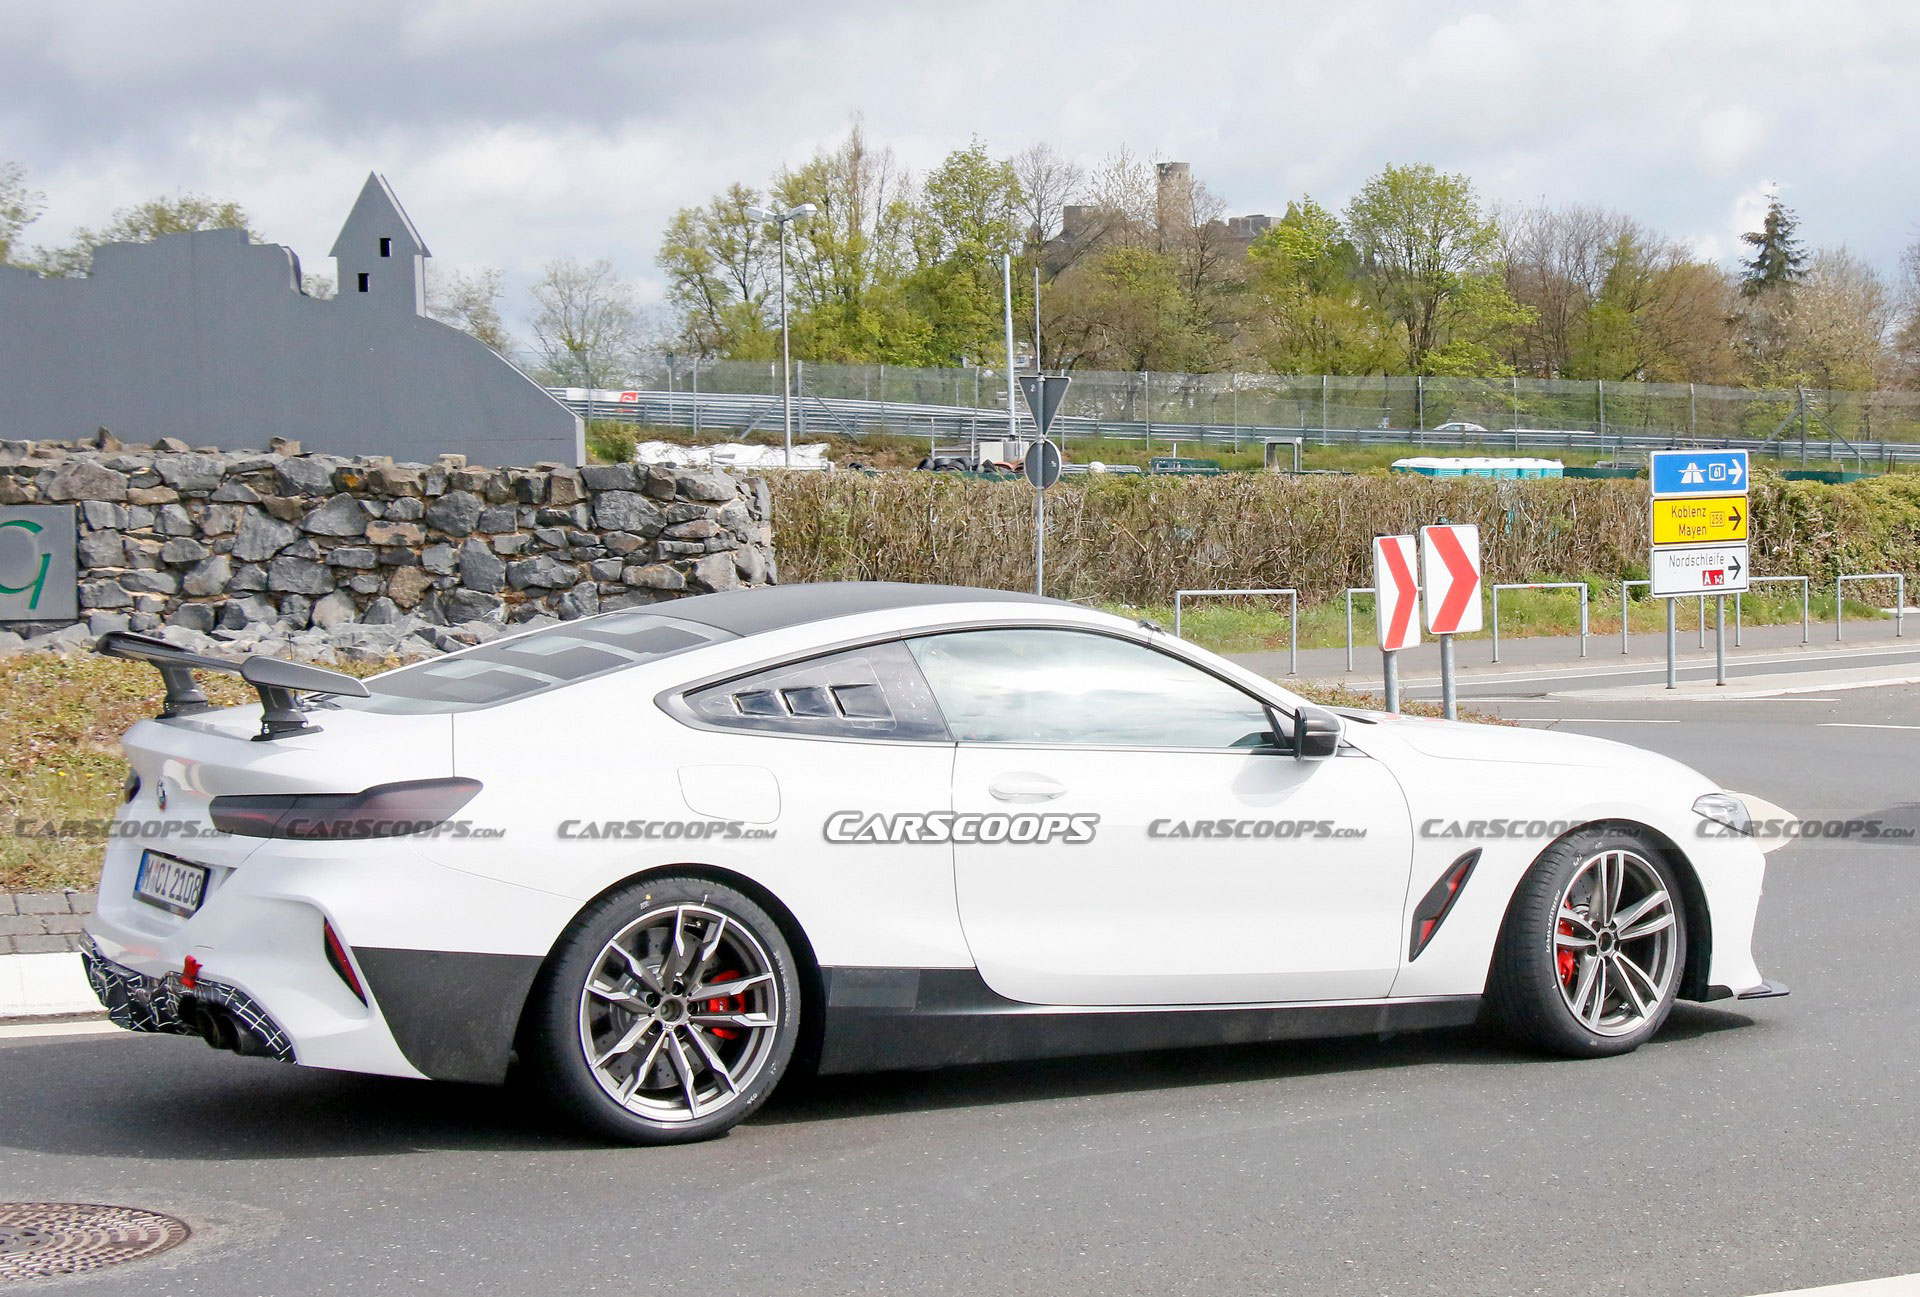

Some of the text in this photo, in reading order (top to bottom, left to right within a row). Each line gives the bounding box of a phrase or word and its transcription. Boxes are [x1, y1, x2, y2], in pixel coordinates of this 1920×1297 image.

[1713, 466, 1721, 478] 61
[1671, 505, 1707, 519] Koblenz
[1711, 513, 1724, 525] 258
[1678, 524, 1707, 539] Mayen
[1669, 552, 1725, 568] Nordschleife
[1703, 571, 1712, 586] A
[169, 867, 202, 906] 2108
